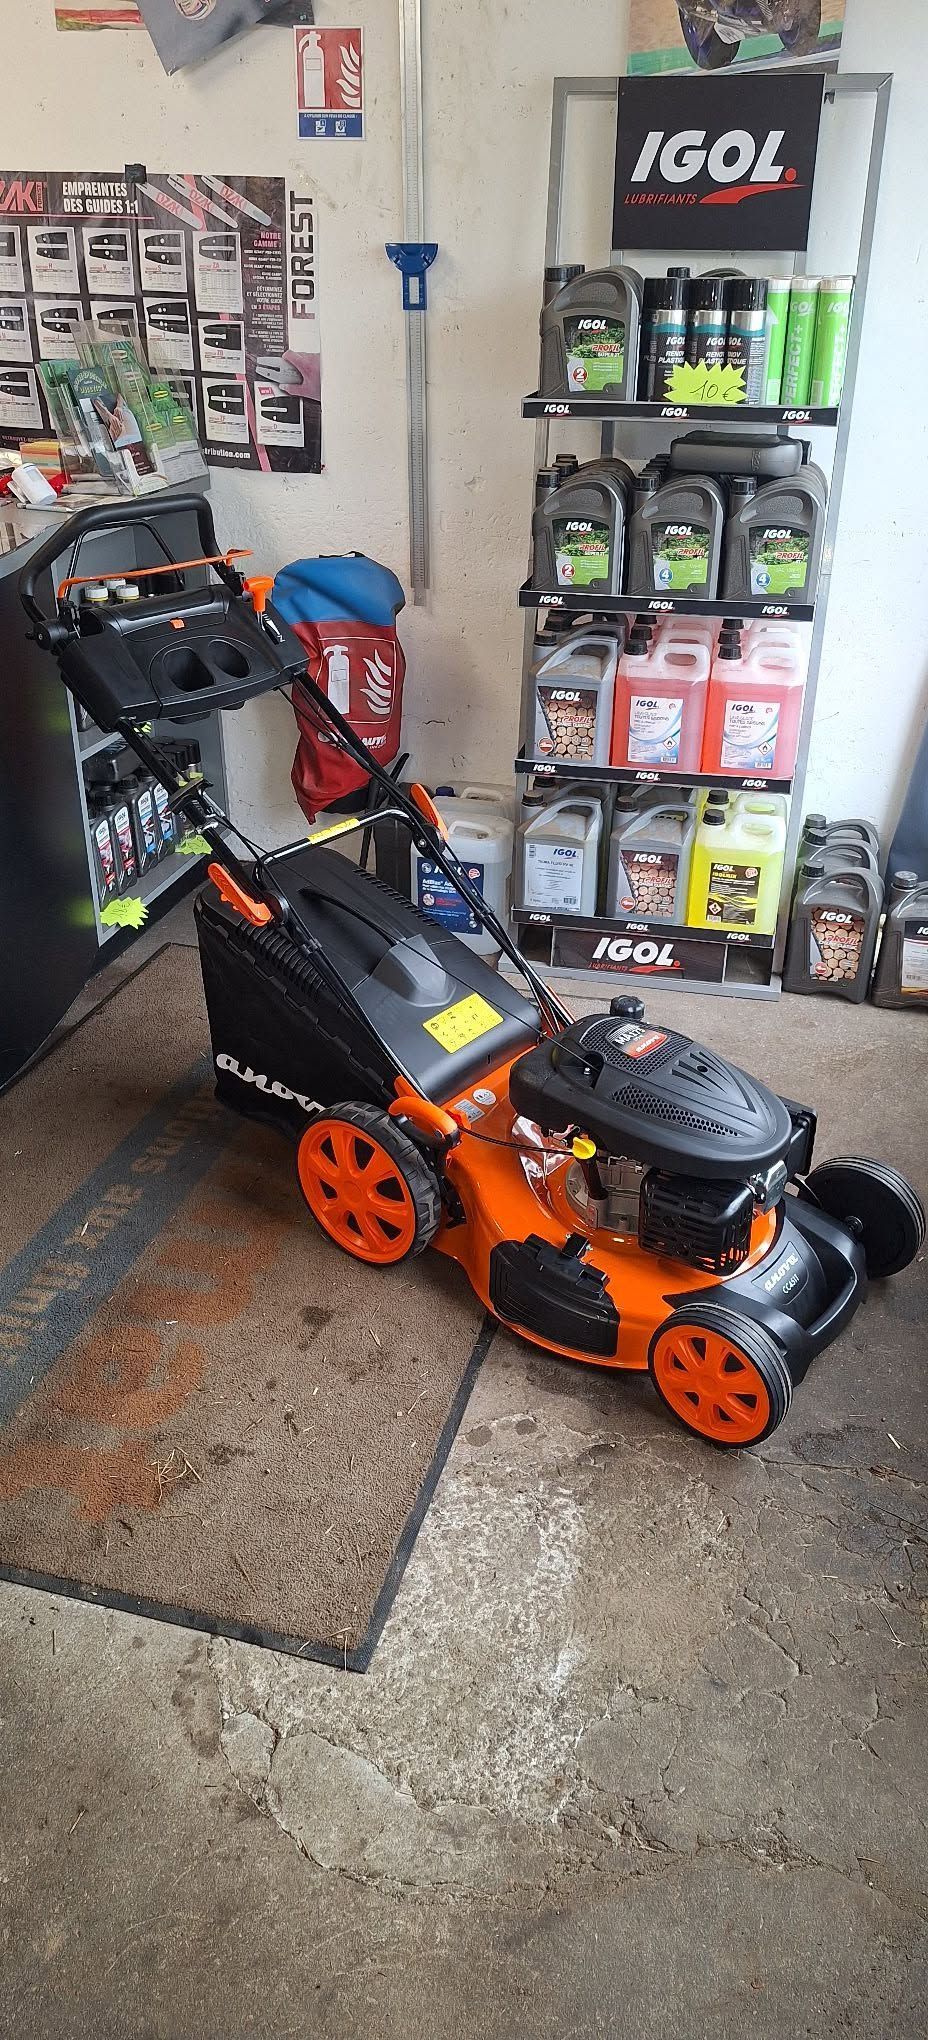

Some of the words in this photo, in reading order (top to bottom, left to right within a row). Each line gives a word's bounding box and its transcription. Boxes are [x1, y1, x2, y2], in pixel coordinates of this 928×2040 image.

[62, 181, 128, 197] EMPREINTES
[624, 193, 698, 205] LUBRIFIANTS
[63, 199, 84, 213] DES
[85, 200, 123, 214] GUIDES
[125, 201, 139, 214] 1:1
[260, 231, 282, 240] NOTRE
[253, 239, 278, 248] GAMME
[290, 191, 315, 320] FOREST
[577, 319, 607, 331] IGOL
[592, 344, 620, 352] PROFIL
[689, 380, 719, 401] 10
[721, 385, 738, 402] €
[544, 404, 571, 414] IGOL
[661, 407, 689, 417] IGOL
[782, 410, 811, 420] IGOL
[200, 446, 251, 460] tribution.com
[565, 521, 593, 532] IGOL
[664, 525, 693, 535] IGOL
[763, 529, 792, 539] IGOL
[677, 548, 705, 556] PROFIL
[539, 595, 564, 605] IGOL
[648, 601, 675, 610] IGOL
[762, 605, 789, 615] IGOL
[550, 690, 581, 701] IGOL
[635, 699, 658, 708] IGOL
[731, 704, 754, 712] IGOL
[563, 715, 591, 724] PROFIL
[533, 764, 557, 773] IGOL
[636, 772, 661, 781] IGOL
[742, 779, 767, 788] IGOL
[553, 848, 577, 858] IGOL
[633, 853, 662, 864] IGOL
[713, 863, 734, 872] IGOL
[529, 913, 551, 922] IGOL
[820, 911, 853, 924] IGOL
[626, 923, 649, 931] IGOL
[726, 932, 751, 941] IGOL
[827, 934, 860, 945] PROFIL
